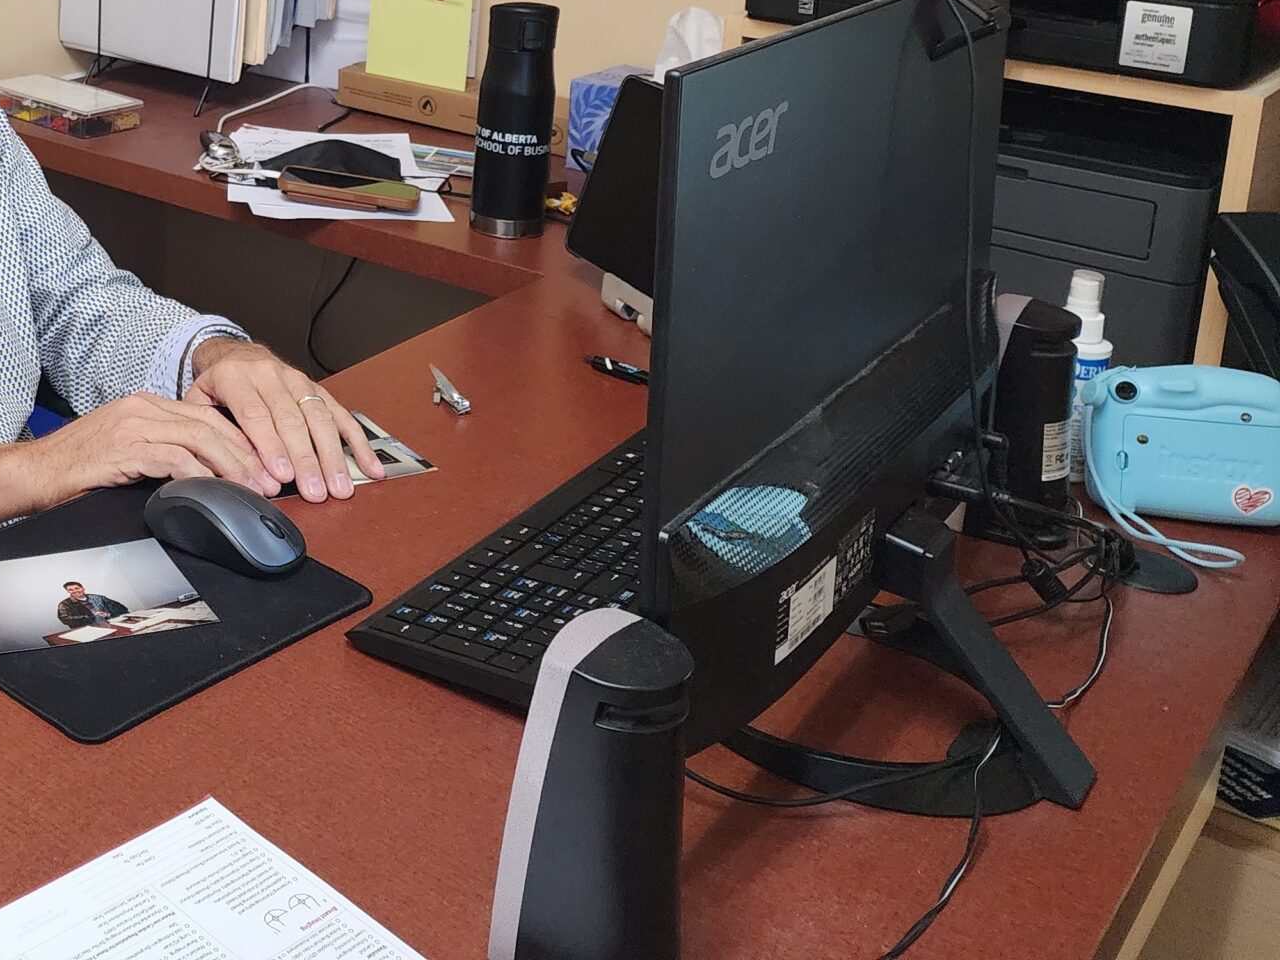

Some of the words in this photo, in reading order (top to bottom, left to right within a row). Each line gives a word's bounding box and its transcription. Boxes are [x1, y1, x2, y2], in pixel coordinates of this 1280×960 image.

[1141, 12, 1176, 25] genuine
[481, 128, 491, 138] OF
[492, 131, 537, 144] ALBERTA
[708, 100, 789, 180] acer
[507, 145, 522, 156] OF
[778, 580, 799, 604] acer
[318, 905, 339, 919] Breast
[297, 916, 323, 931] Imaging
[364, 944, 389, 959] Vascular
